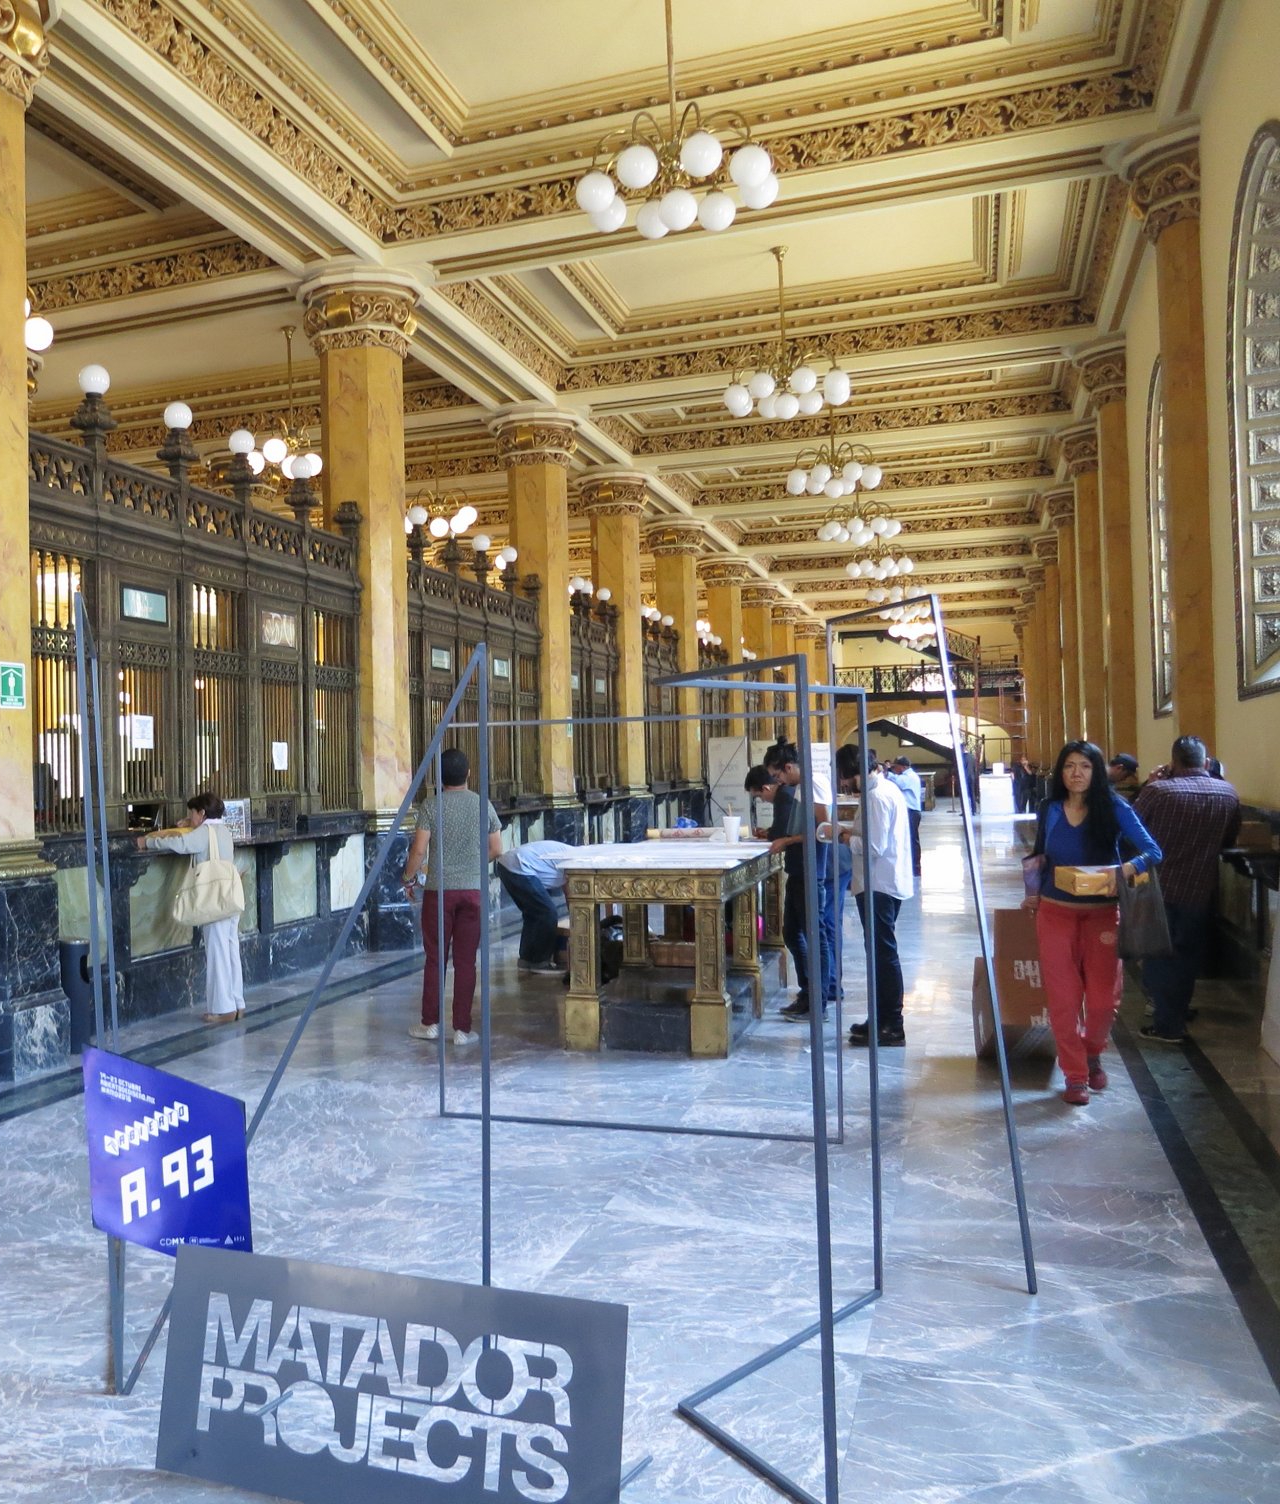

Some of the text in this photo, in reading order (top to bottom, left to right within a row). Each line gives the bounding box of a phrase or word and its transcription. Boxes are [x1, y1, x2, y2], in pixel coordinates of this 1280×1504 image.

[116, 1102, 187, 1148] ABIERTO
[120, 1134, 214, 1225] A.93
[159, 1236, 186, 1247] CDMX
[203, 1291, 574, 1428] MATADOR
[196, 1362, 570, 1503] PROJECTS
